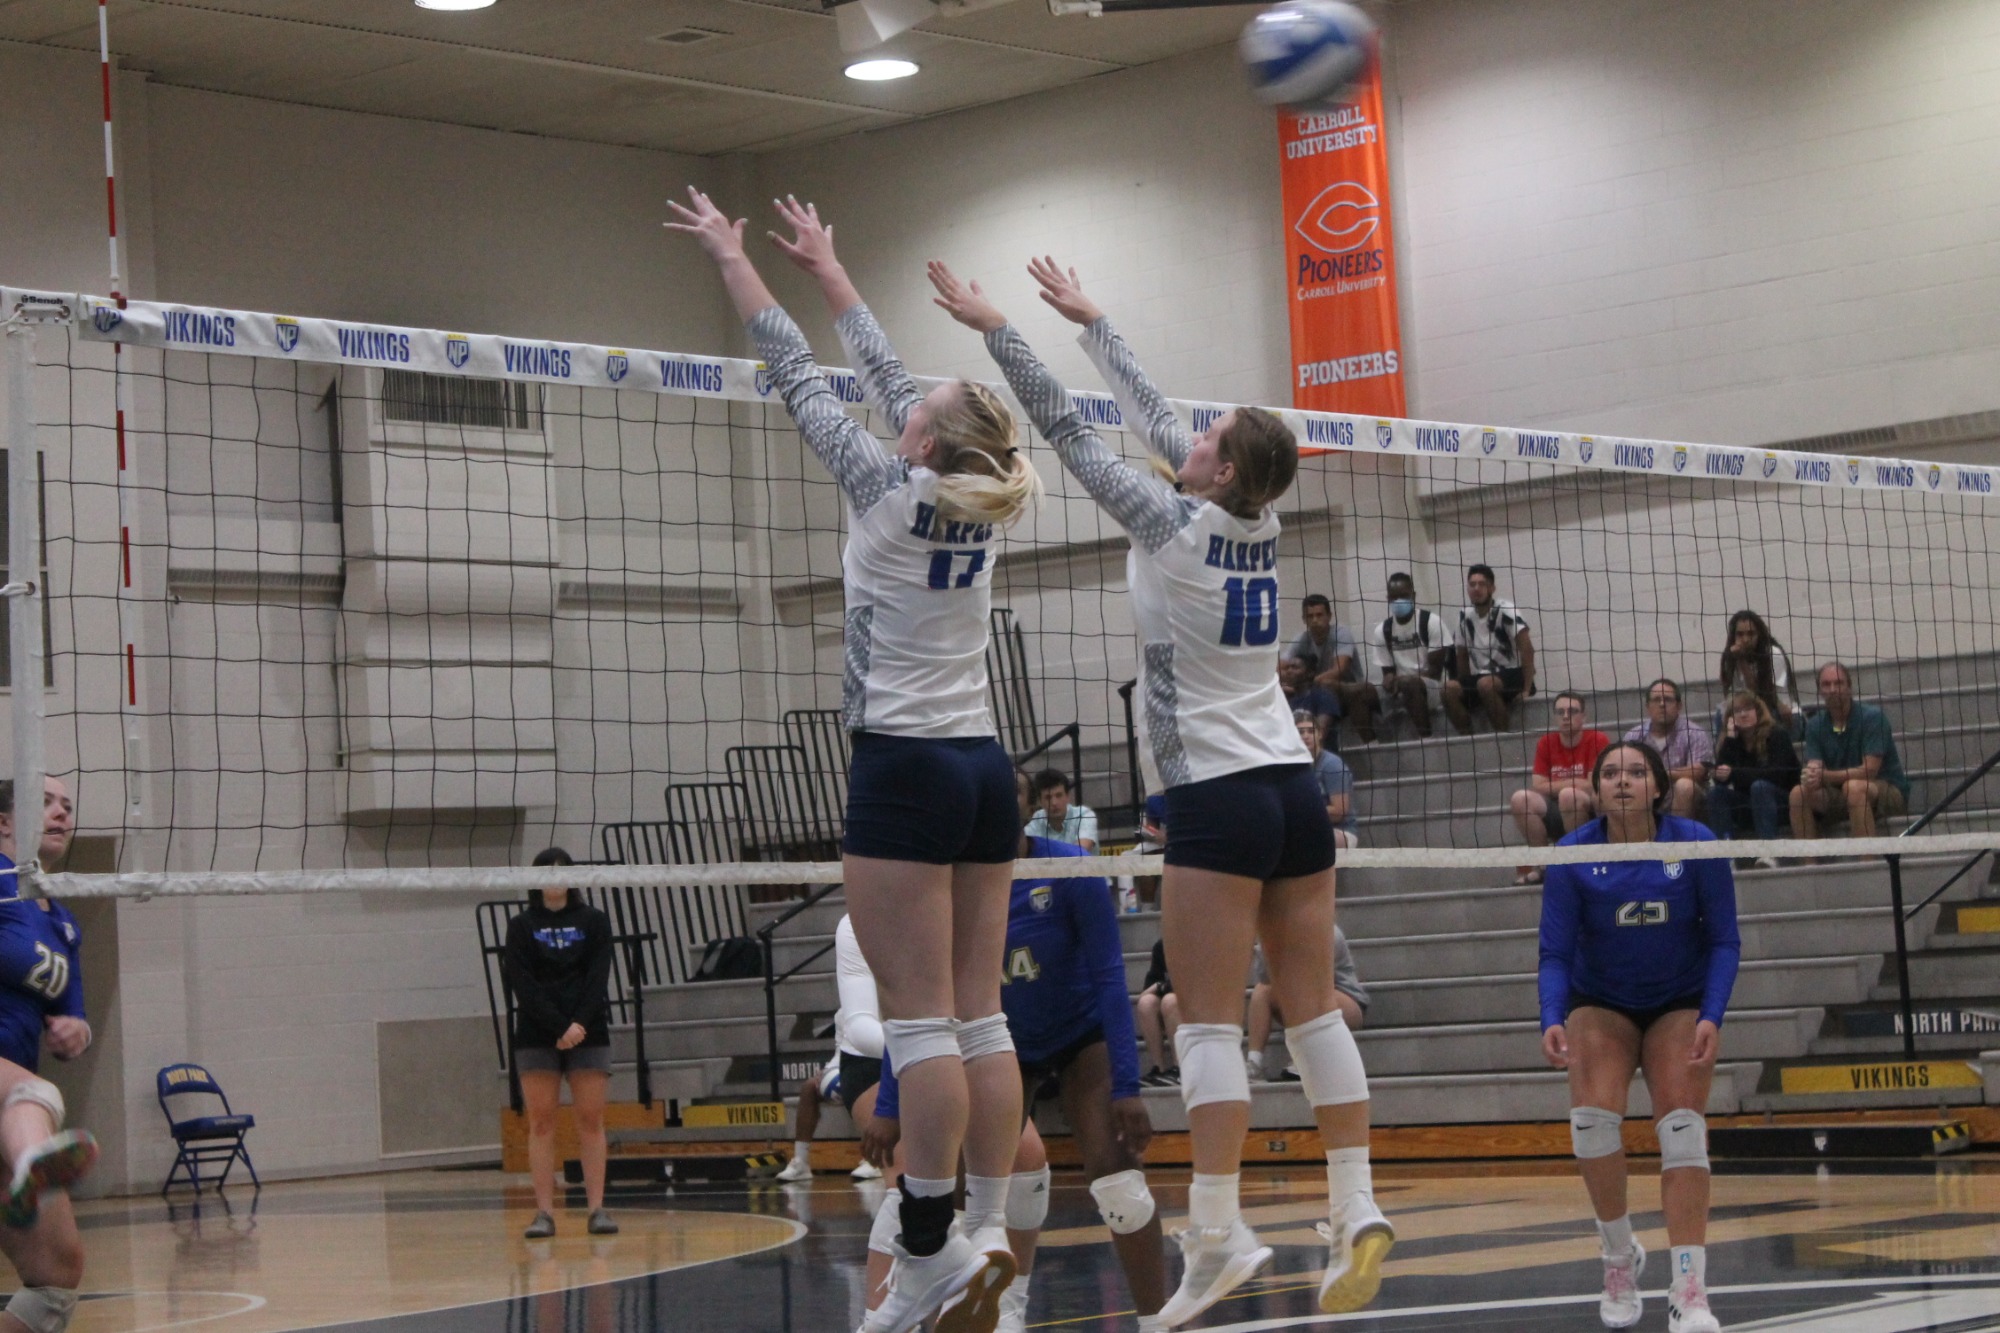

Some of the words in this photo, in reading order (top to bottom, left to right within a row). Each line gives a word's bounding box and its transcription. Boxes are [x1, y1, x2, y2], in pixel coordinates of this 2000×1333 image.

[1297, 106, 1365, 135] CARROLL
[1286, 124, 1378, 160] UNIVERSITY
[1297, 249, 1384, 286] PIONEERS
[1298, 350, 1399, 388] PIONEERS
[162, 311, 235, 346] VIKINGS
[338, 329, 410, 362] VIKINGS
[504, 345, 571, 378] VIKINGS
[661, 360, 722, 392] VIKINGS
[1307, 419, 1353, 445] VIKINGS
[1416, 428, 1459, 453] VIKINGS
[1518, 434, 1559, 459] VIKINGS
[1614, 444, 1653, 469] VIKINGS
[1705, 453, 1744, 475] VIKINGS
[1795, 460, 1831, 482] VIKINGS
[1876, 466, 1913, 487] VIKINGS
[1957, 470, 1990, 493] VIKINGS
[926, 548, 986, 590] 17
[1219, 577, 1278, 647] 10
[24, 940, 69, 1000] 20
[1851, 1065, 1929, 1089] VIKINGS
[727, 1106, 778, 1124] VIKINGS
